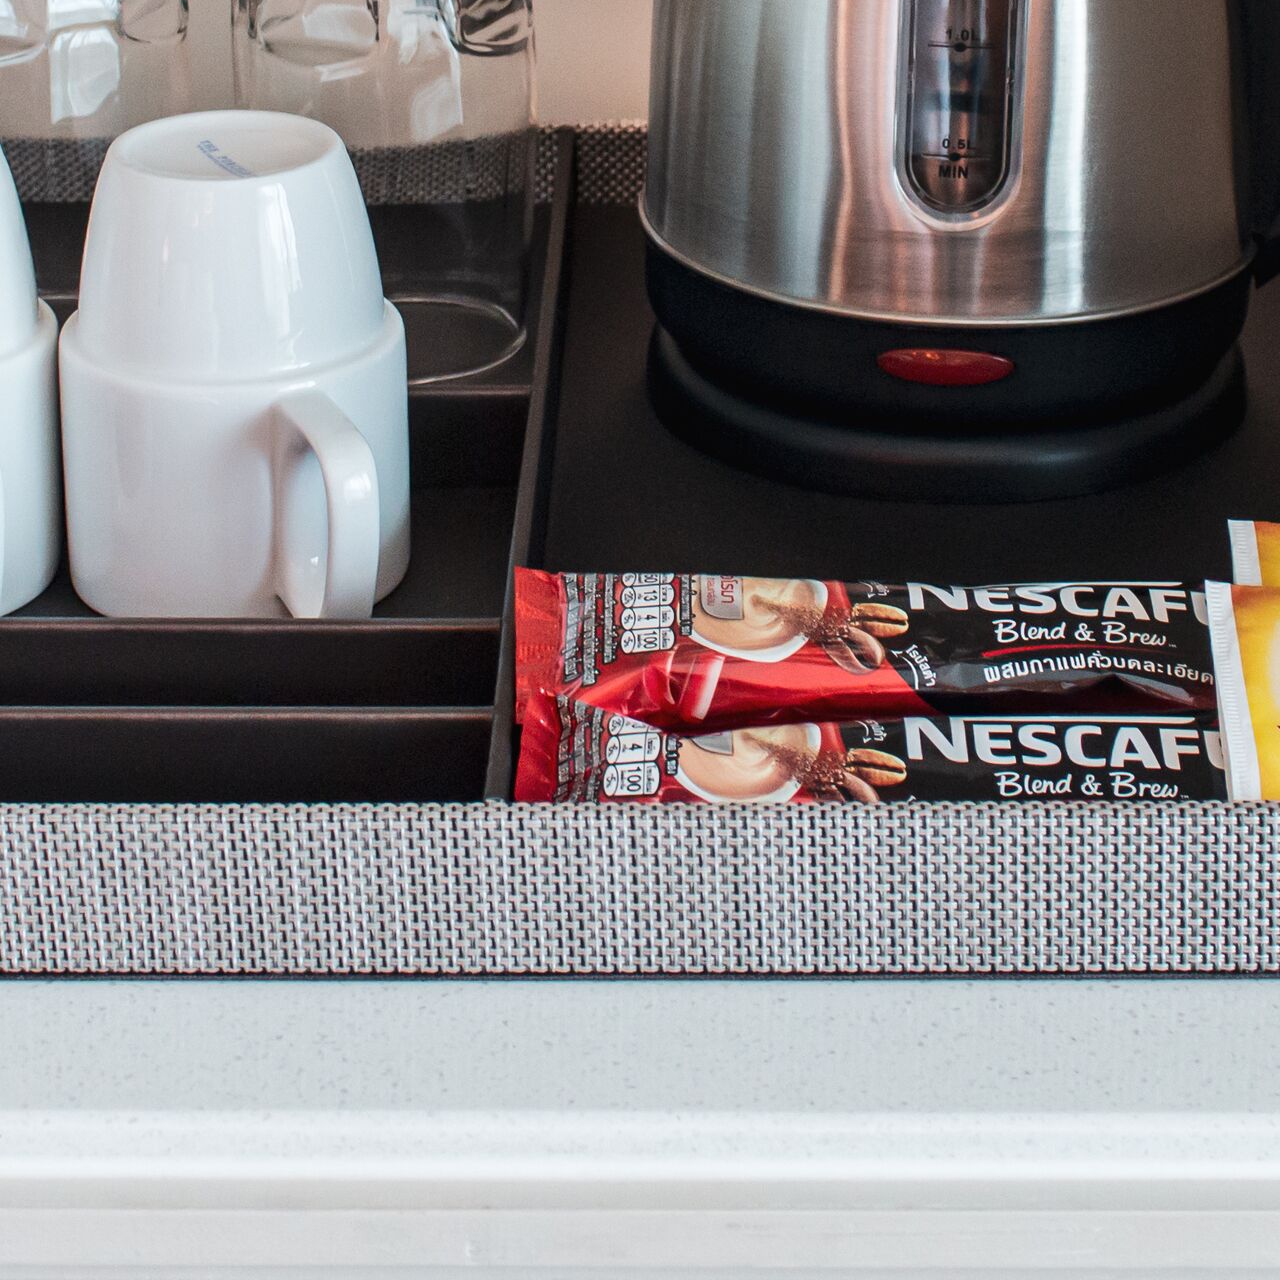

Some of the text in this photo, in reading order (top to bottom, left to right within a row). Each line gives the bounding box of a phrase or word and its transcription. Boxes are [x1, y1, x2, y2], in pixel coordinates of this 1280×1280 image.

[945, 27, 978, 41] 1.0L
[941, 136, 976, 151] 0.5L
[938, 164, 969, 180] MIN
[644, 590, 658, 602] 13
[643, 630, 658, 649] 100
[991, 619, 1167, 647] Blend & Brew
[983, 651, 1215, 686] ผสมกาแฟคั่วบดละเอียด
[629, 743, 643, 751] 4
[626, 766, 642, 792] 100
[994, 771, 1180, 799] Blend & Brew
